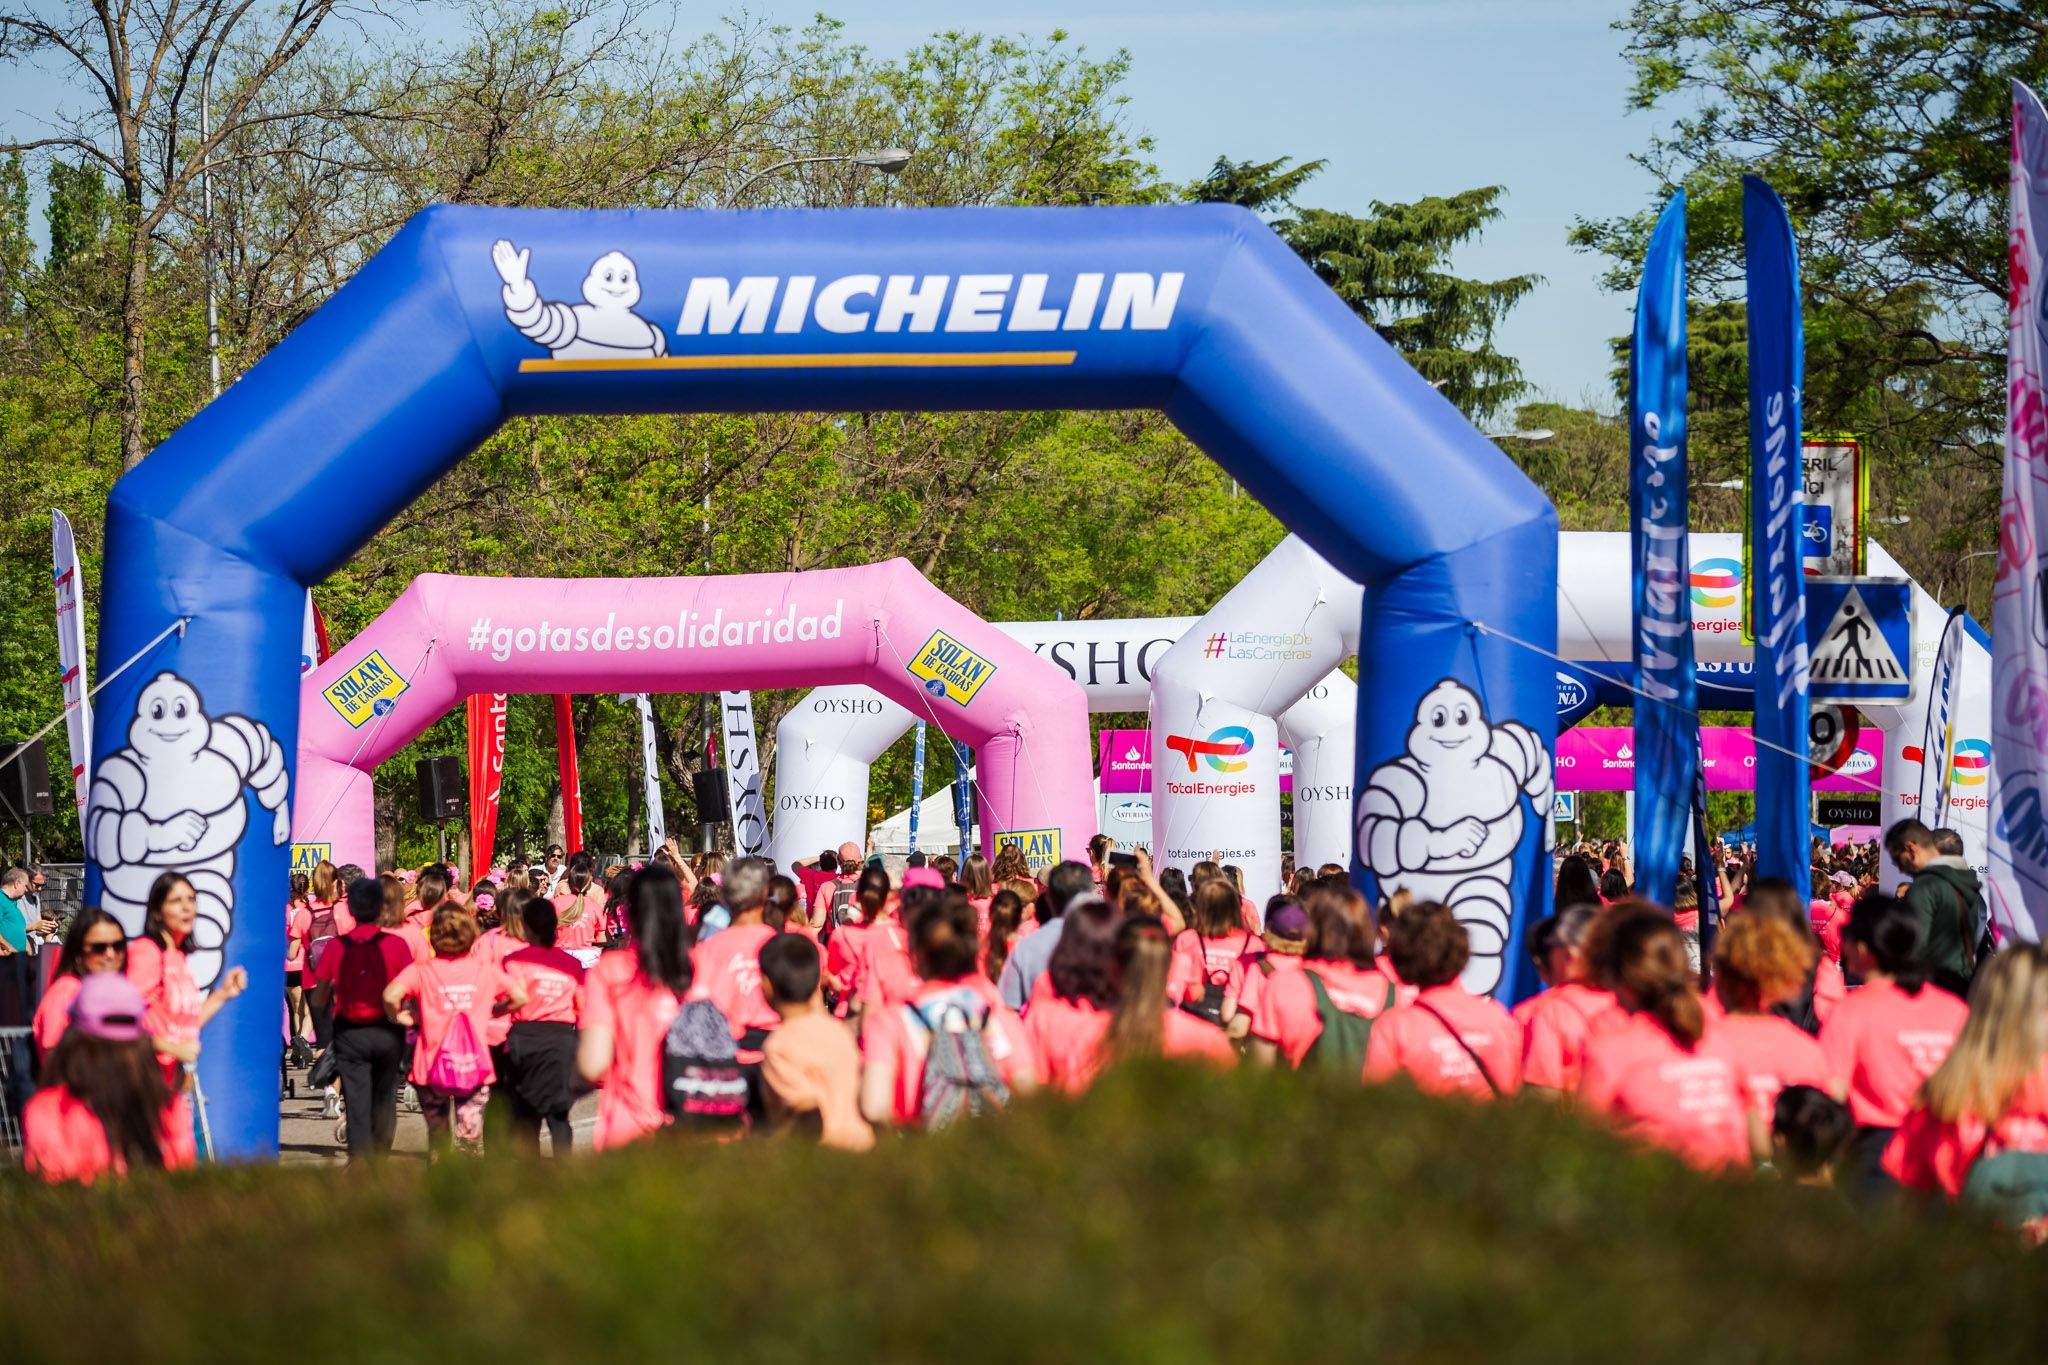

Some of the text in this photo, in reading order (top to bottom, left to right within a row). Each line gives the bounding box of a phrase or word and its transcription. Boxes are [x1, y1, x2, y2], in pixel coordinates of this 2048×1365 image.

[676, 272, 1185, 335] MICHELIN
[1801, 458, 1837, 471] RRIL
[1803, 481, 1824, 494] ICI
[467, 598, 843, 662] #gotasdesolidaridad
[921, 654, 973, 692] DE CABRAS
[344, 673, 393, 714] DE CABRAS
[813, 698, 884, 715] OYSHO
[726, 690, 763, 854] OYSH
[1167, 781, 1256, 797] TotalEnergies
[1301, 785, 1350, 802] OYSH
[780, 794, 845, 811] OYSHO
[1828, 808, 1873, 820] OYSHO
[1168, 848, 1256, 860] totalenegies.es
